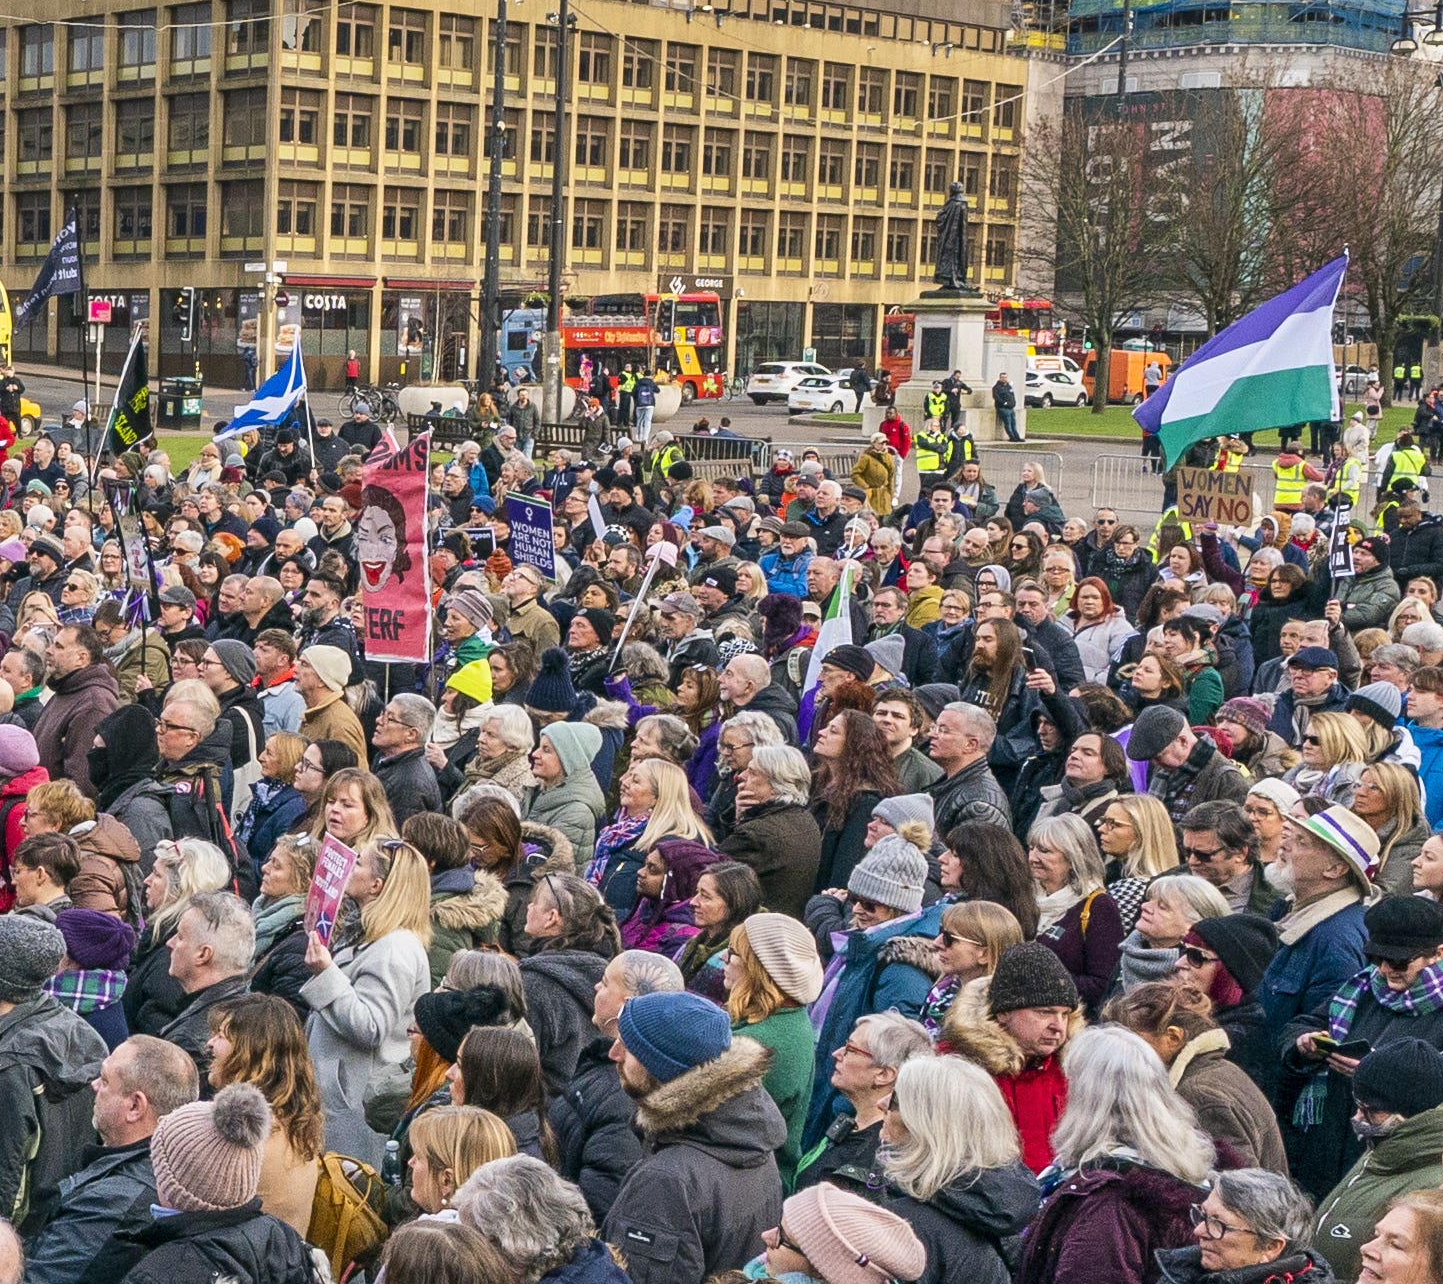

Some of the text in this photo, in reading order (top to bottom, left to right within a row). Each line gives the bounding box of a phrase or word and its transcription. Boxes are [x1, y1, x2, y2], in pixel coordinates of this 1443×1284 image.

[695, 278, 724, 288] GEORGE
[305, 294, 348, 310] COSTA
[1180, 469, 1252, 497] WOMEN
[1182, 493, 1250, 523] SAY NO
[511, 519, 550, 538] WOMEN
[511, 530, 552, 549] ARE NOT
[514, 539, 551, 558] HUMAN
[513, 550, 553, 570] SHIELDS
